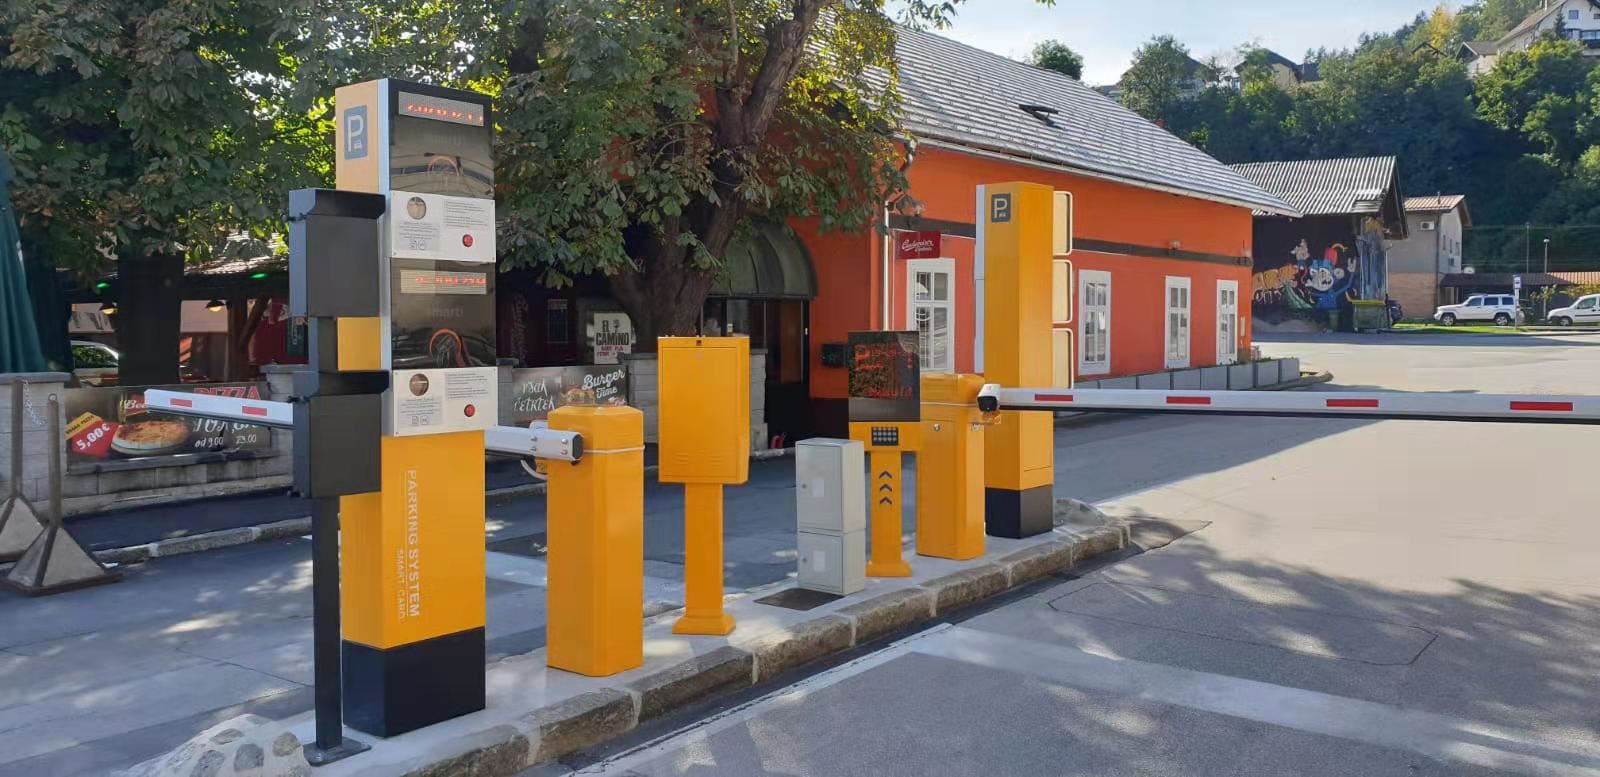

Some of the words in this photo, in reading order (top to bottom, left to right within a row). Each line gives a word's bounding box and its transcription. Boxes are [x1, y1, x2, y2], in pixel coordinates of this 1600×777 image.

[347, 114, 364, 152] P
[993, 198, 1008, 218] P
[596, 332, 629, 346] CAMINO
[581, 369, 626, 391] Burger
[596, 386, 618, 399] Time
[76, 423, 110, 450] 5,00€
[407, 469, 418, 545] PARKING
[408, 550, 420, 617] SYSTEM
